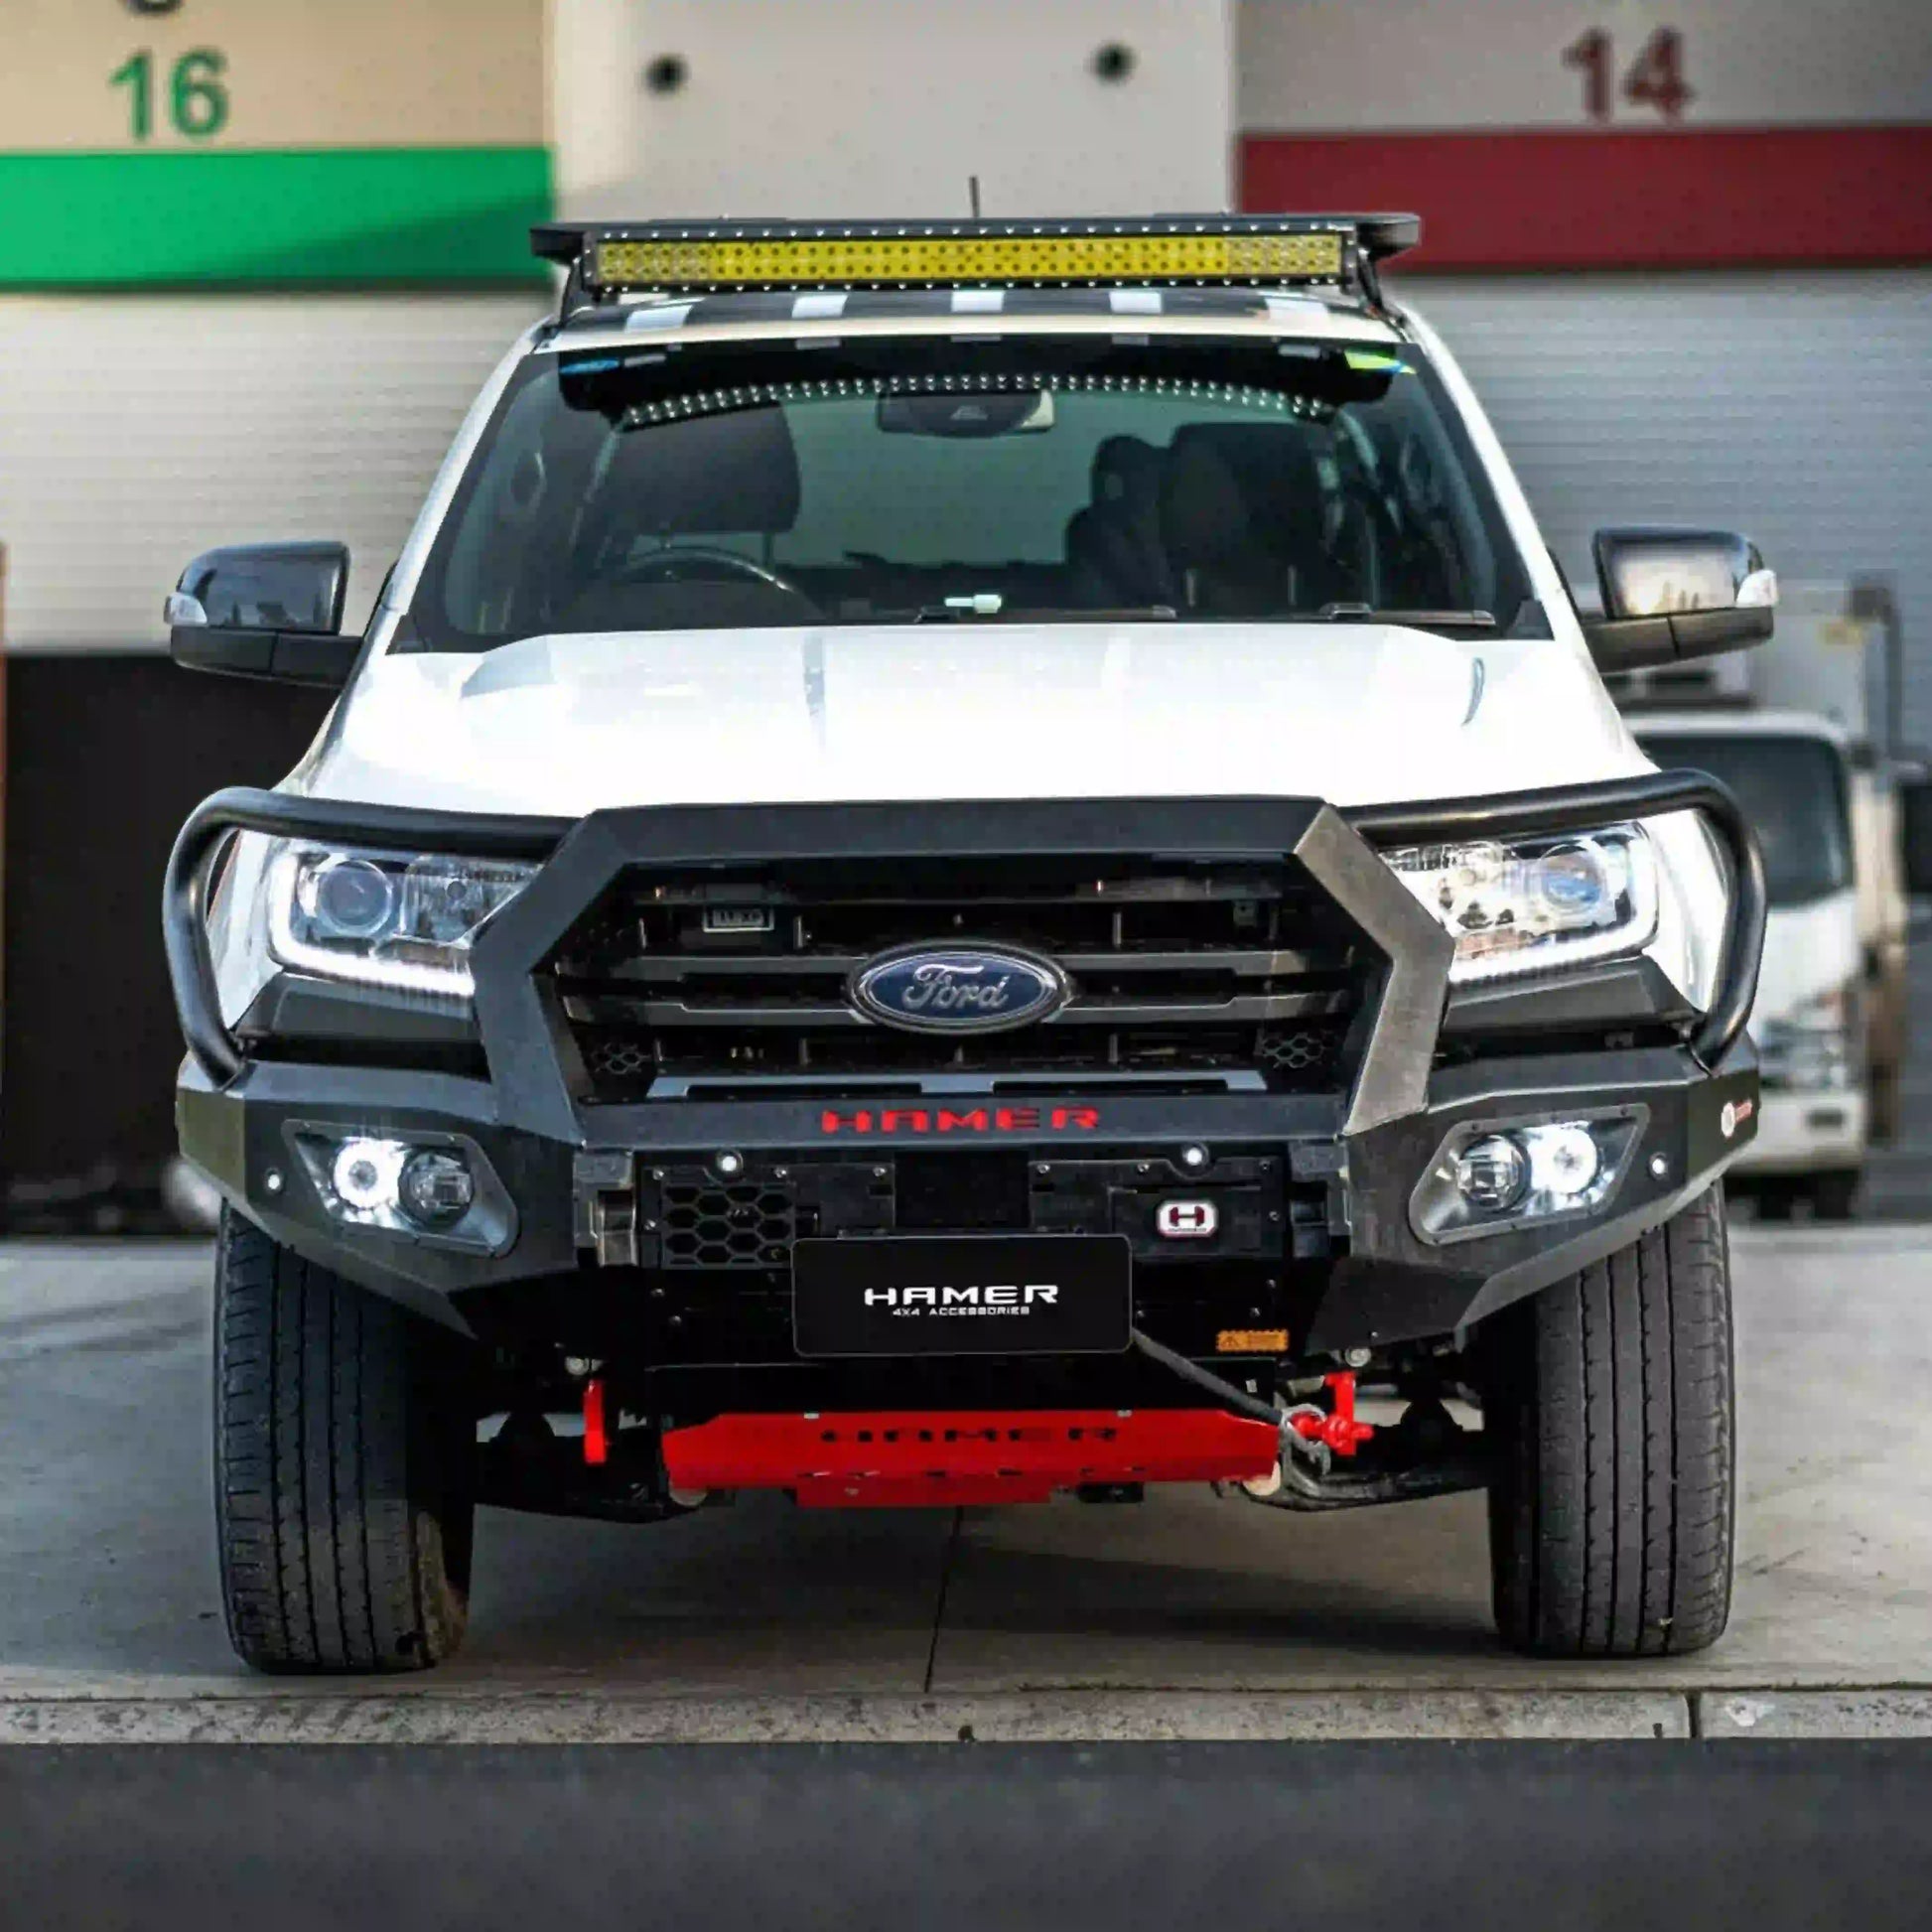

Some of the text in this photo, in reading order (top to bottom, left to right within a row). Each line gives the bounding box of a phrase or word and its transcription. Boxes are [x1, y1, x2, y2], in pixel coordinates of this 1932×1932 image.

[1562, 26, 1698, 125] 14
[108, 46, 230, 142] 16
[901, 963, 1011, 1010] Ford
[821, 1107, 1099, 1133] HAMER
[864, 1285, 1059, 1306] HAMER
[928, 1307, 1031, 1316] ACCESSORIES
